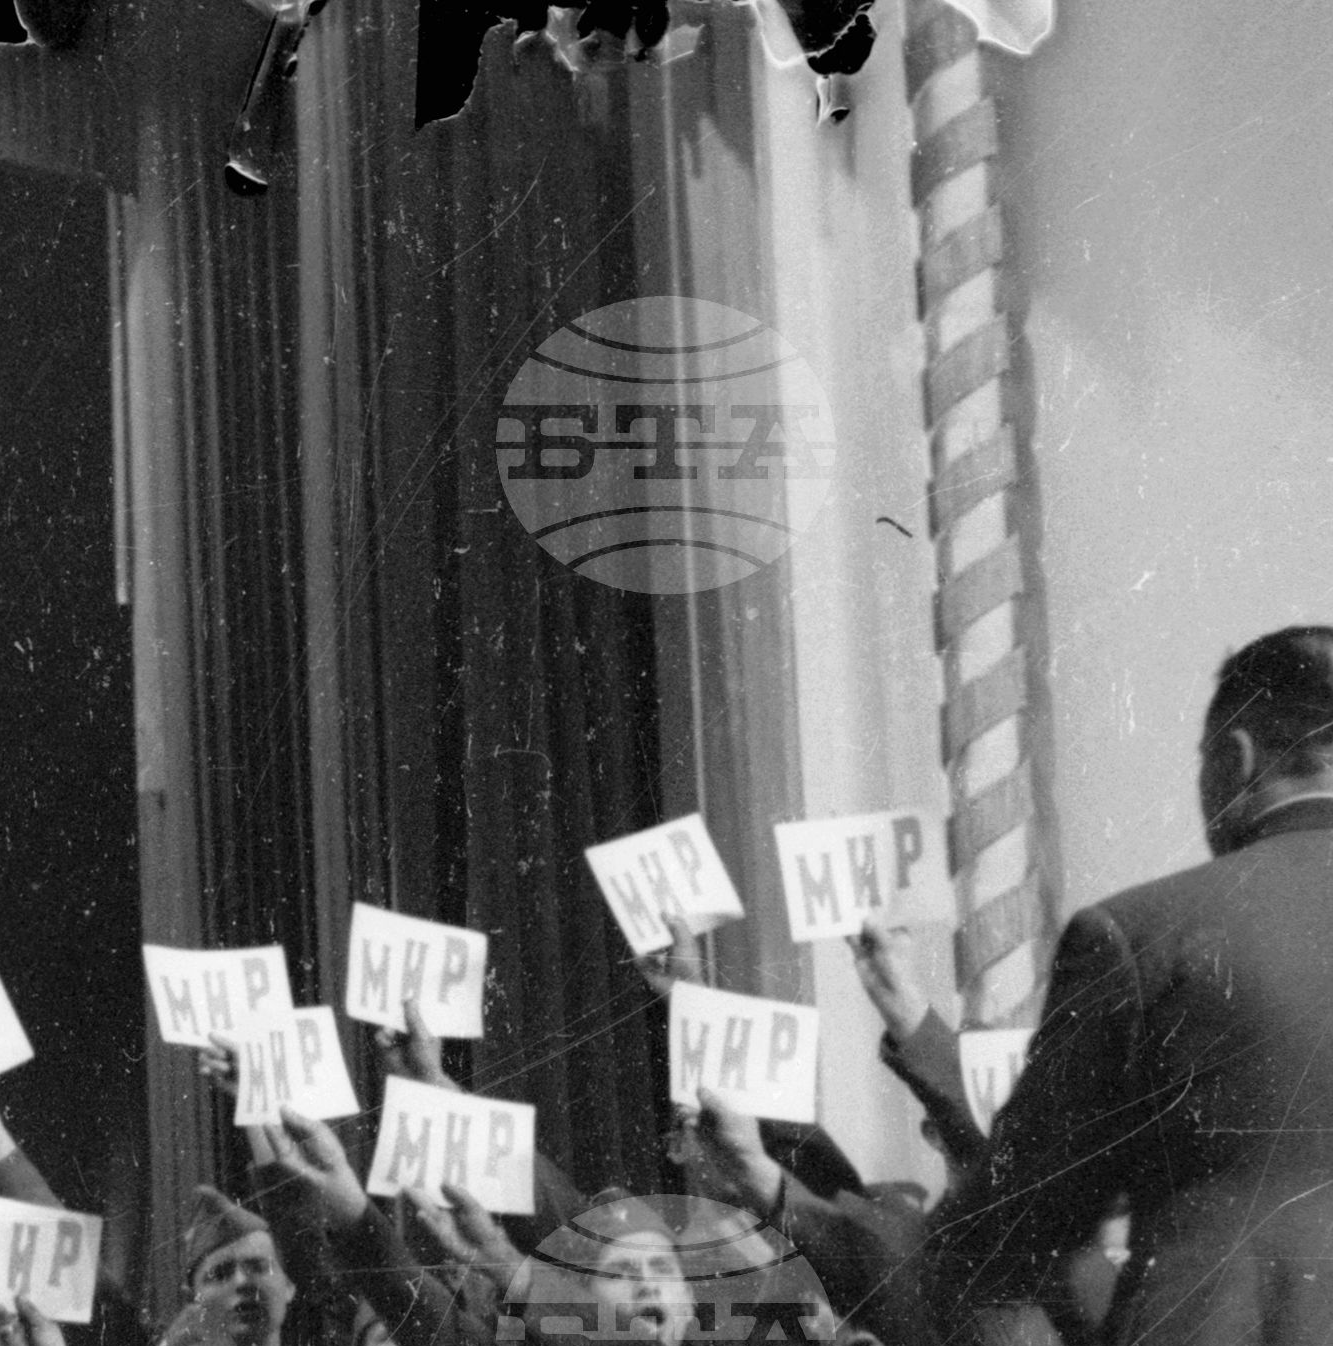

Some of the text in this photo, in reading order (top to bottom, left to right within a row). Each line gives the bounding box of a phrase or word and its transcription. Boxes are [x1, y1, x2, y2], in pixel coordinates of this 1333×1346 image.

[609, 829, 704, 940] МИР
[796, 815, 924, 927] МИР
[160, 957, 271, 1036] МИР
[360, 935, 469, 1013] МИР
[245, 1018, 323, 1114] МИР
[681, 1011, 800, 1092] МИР
[385, 1110, 516, 1190] МИР
